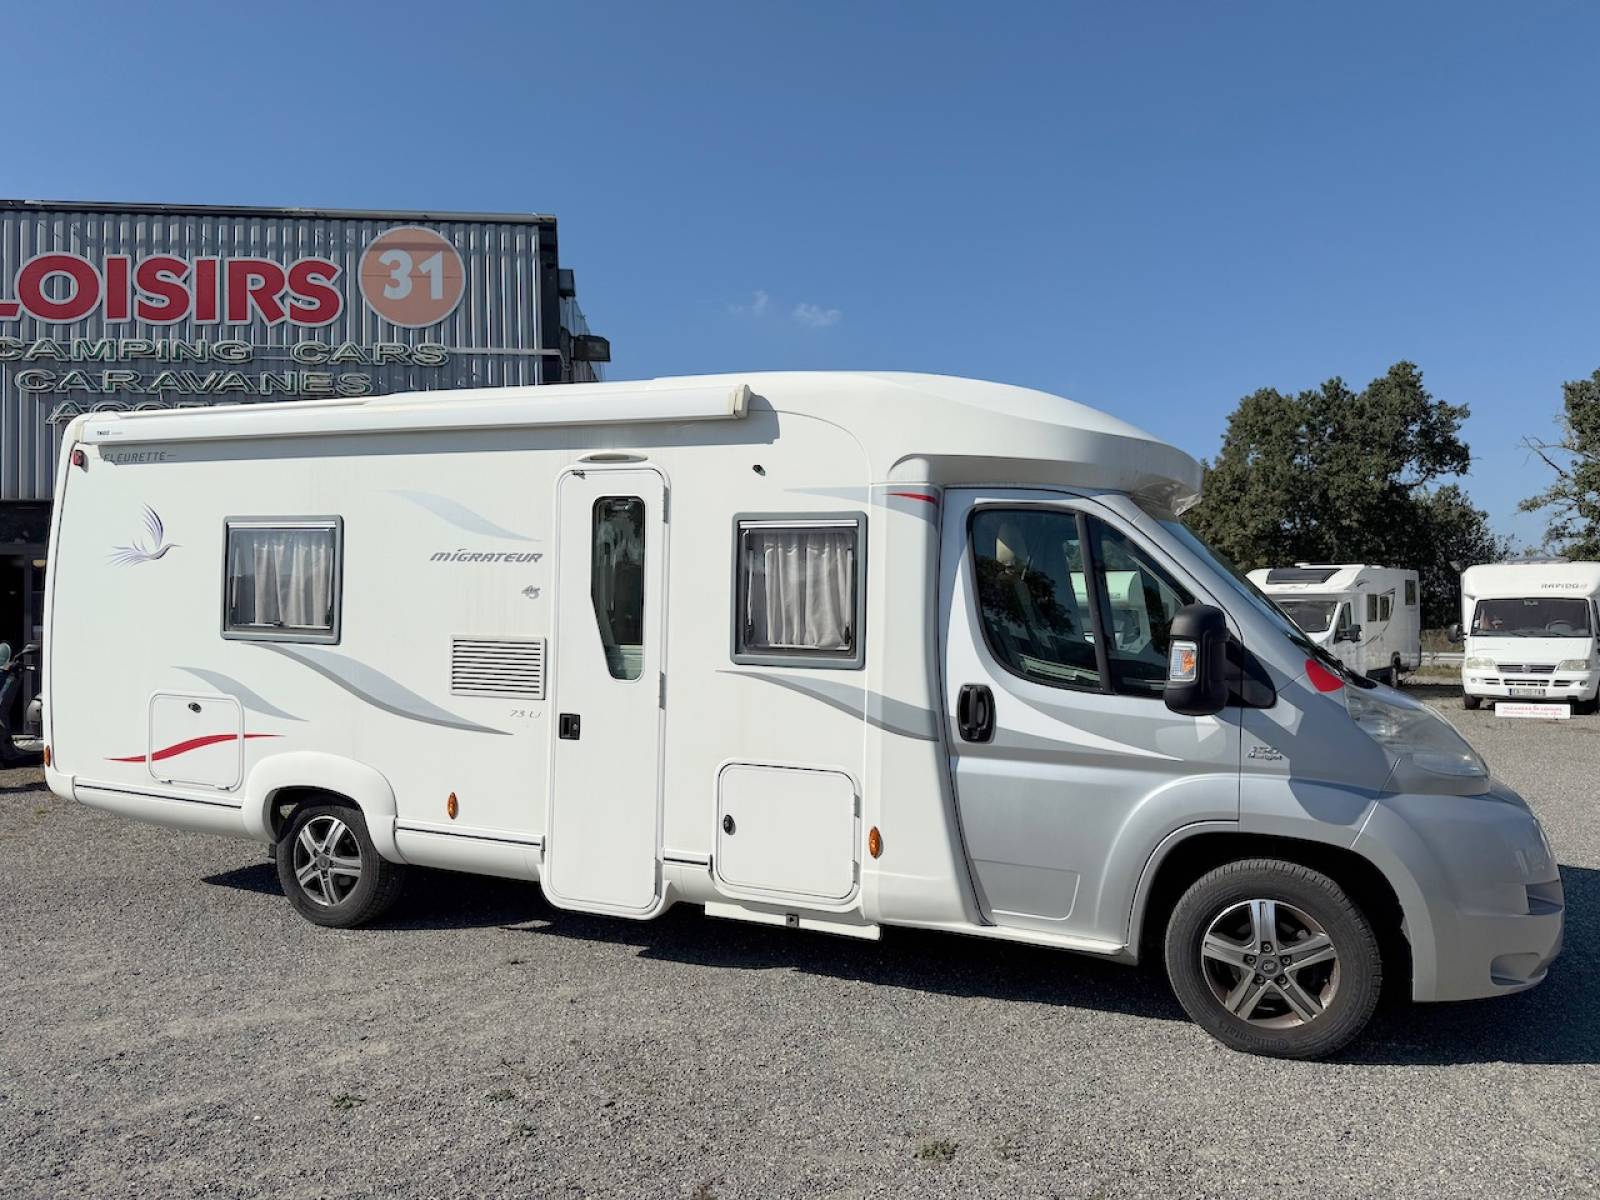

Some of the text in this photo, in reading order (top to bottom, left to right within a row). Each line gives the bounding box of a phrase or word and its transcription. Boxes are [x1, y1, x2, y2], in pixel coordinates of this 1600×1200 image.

[378, 249, 444, 300] 31
[290, 341, 450, 366] CARS
[15, 369, 374, 396] CARAVANES
[104, 451, 167, 463] FLEURETTE
